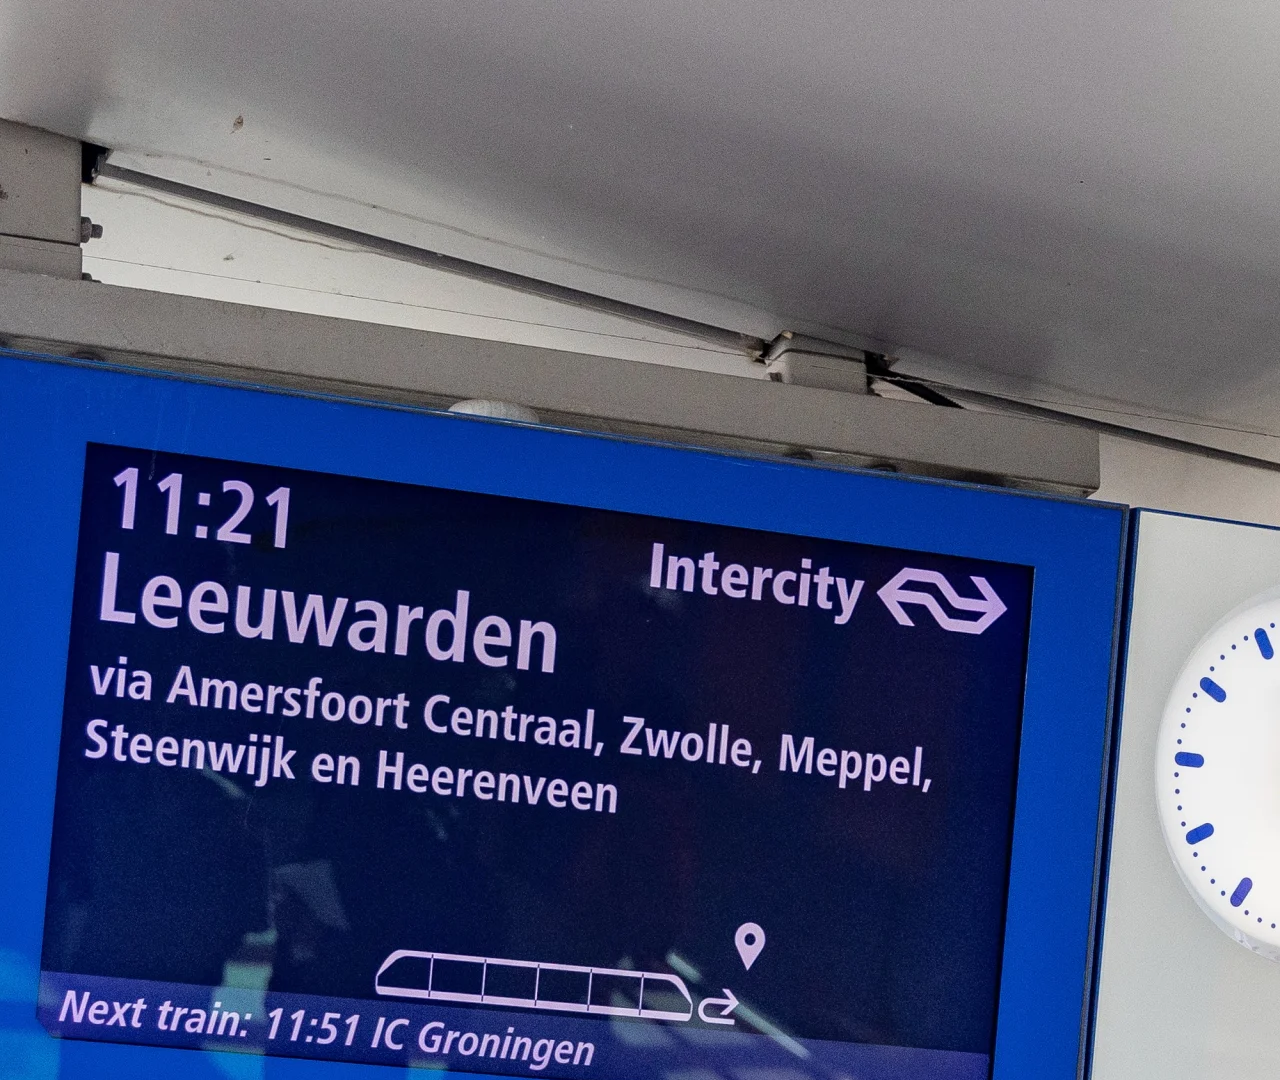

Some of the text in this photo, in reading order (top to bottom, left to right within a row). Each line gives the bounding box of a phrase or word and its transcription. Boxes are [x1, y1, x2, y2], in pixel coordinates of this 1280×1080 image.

[113, 466, 291, 549] 11:21
[99, 551, 558, 674] Leeuwarden
[649, 542, 865, 625] Intercity
[84, 718, 618, 814] Steenwijk en Heerenveen
[90, 656, 933, 793] via Amersfoort Centraal, Zwolle, Meppel,
[58, 988, 596, 1072] Next train: 11:51 IC Groningen
